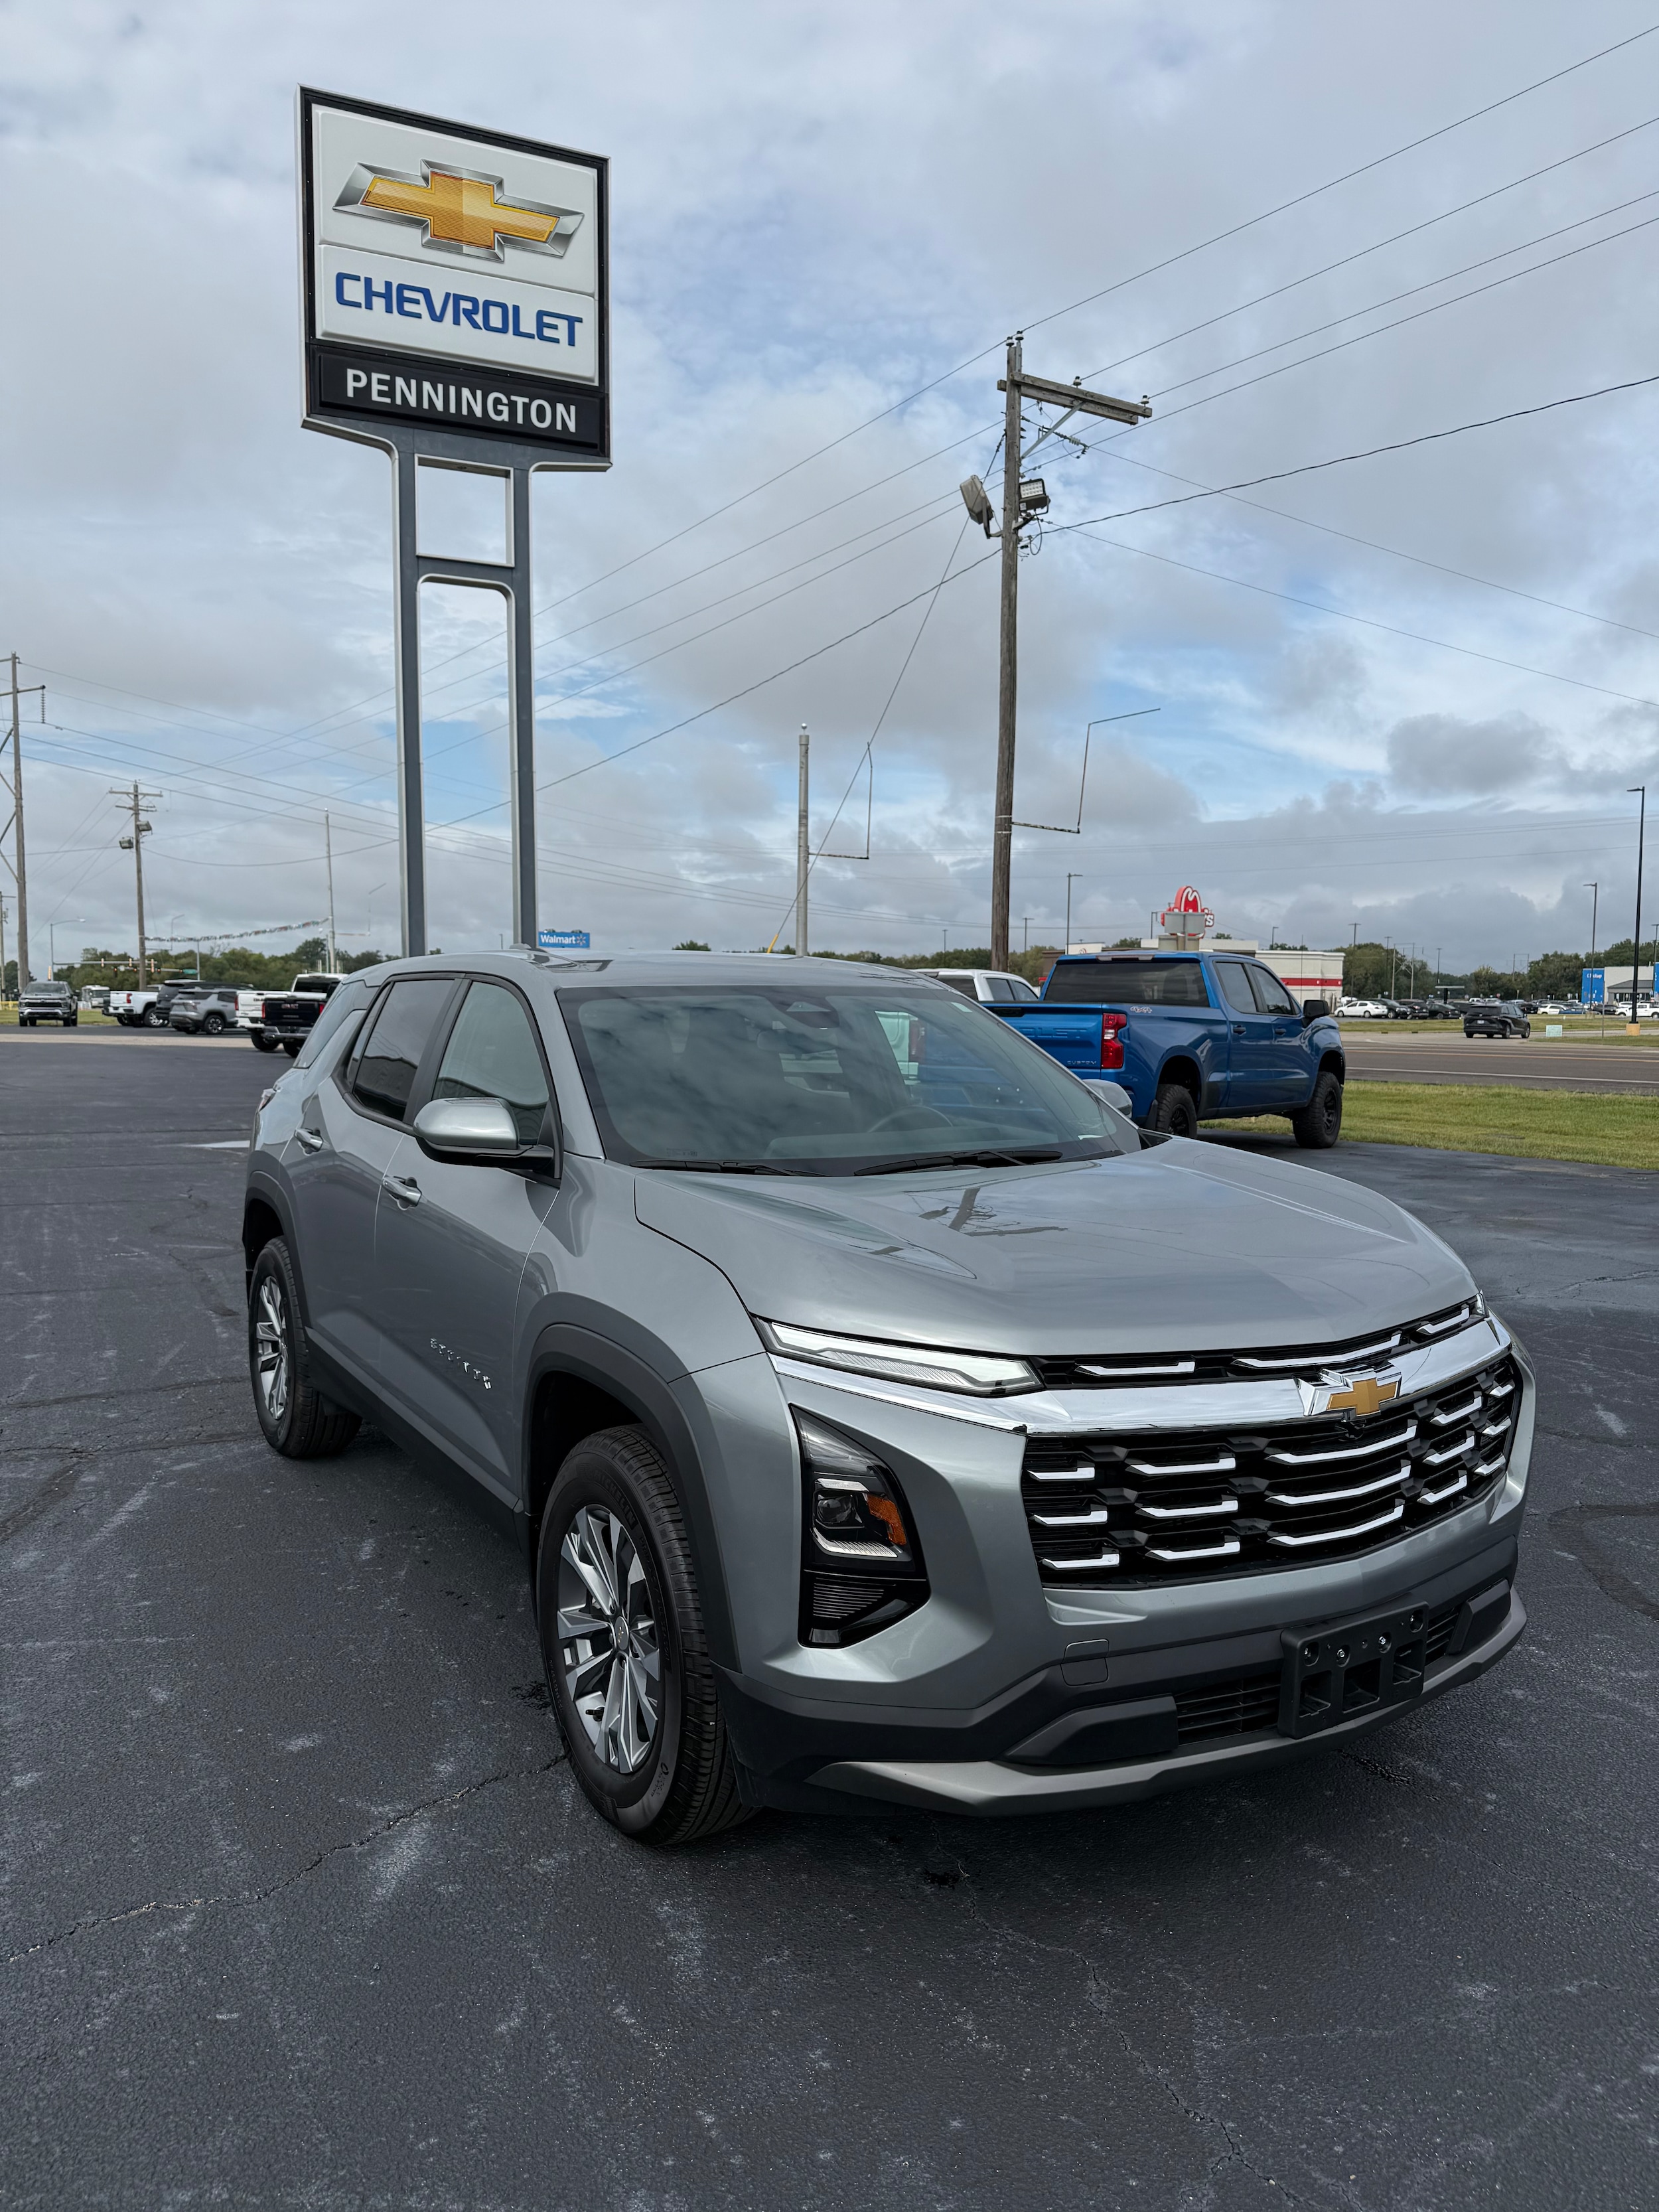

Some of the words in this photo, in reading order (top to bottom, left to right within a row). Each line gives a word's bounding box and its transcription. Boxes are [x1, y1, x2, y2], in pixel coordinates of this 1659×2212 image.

[336, 271, 583, 346] CHEVROLET
[346, 368, 577, 433] PENNINGTON
[540, 934, 576, 944] Walmart
[593, 1469, 637, 1524] MICHELIN
